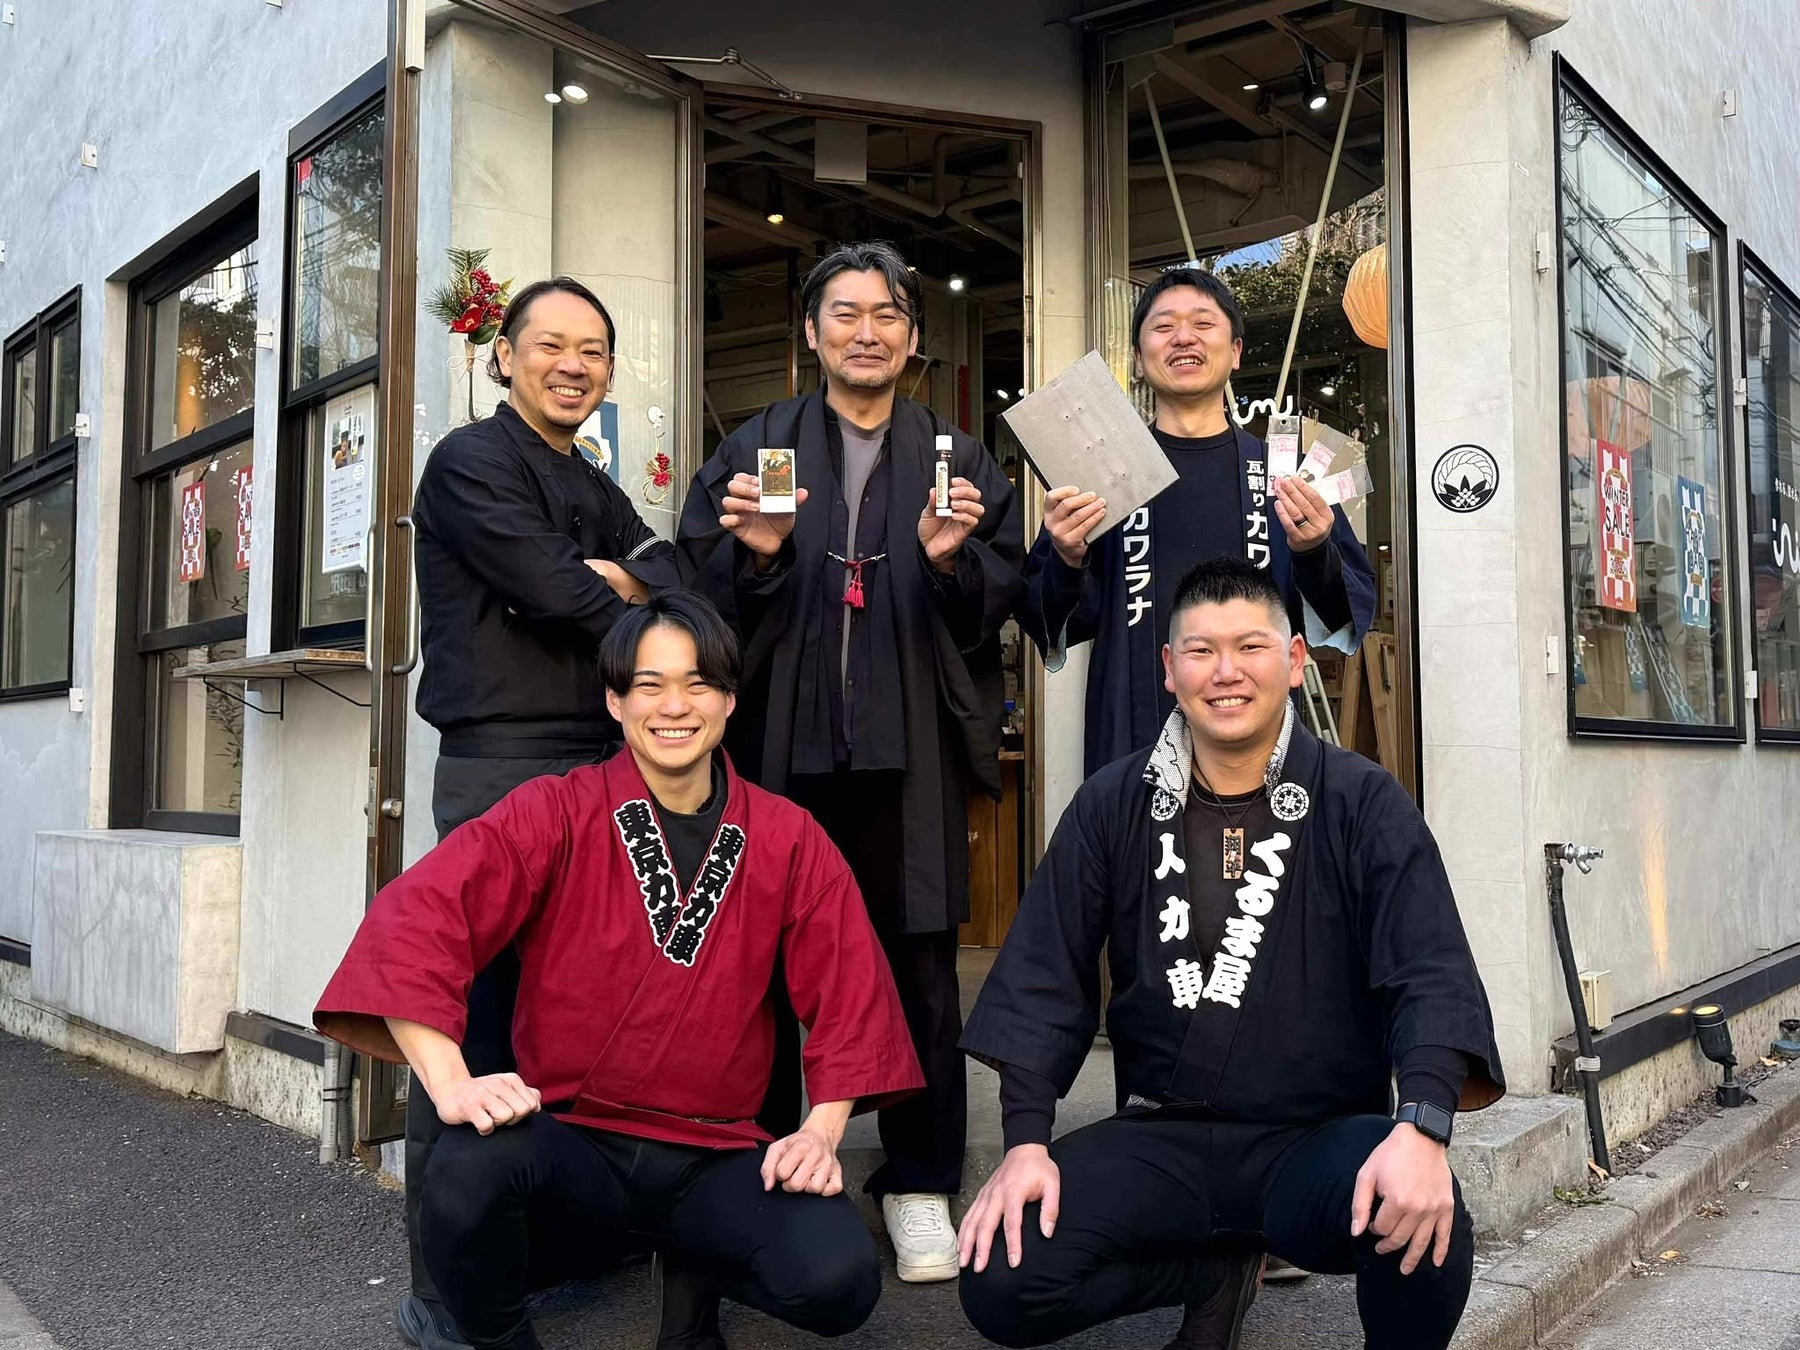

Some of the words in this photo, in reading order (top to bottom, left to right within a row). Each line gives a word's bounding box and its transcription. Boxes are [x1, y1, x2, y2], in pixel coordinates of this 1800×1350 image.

[184, 520, 200, 539] SALE
[1604, 484, 1629, 508] WINTER
[1605, 505, 1630, 538] SALE
[1122, 507, 1153, 627] カワラナ
[1154, 832, 1203, 1010] 人力車
[1202, 831, 1292, 1010] くるま屋
